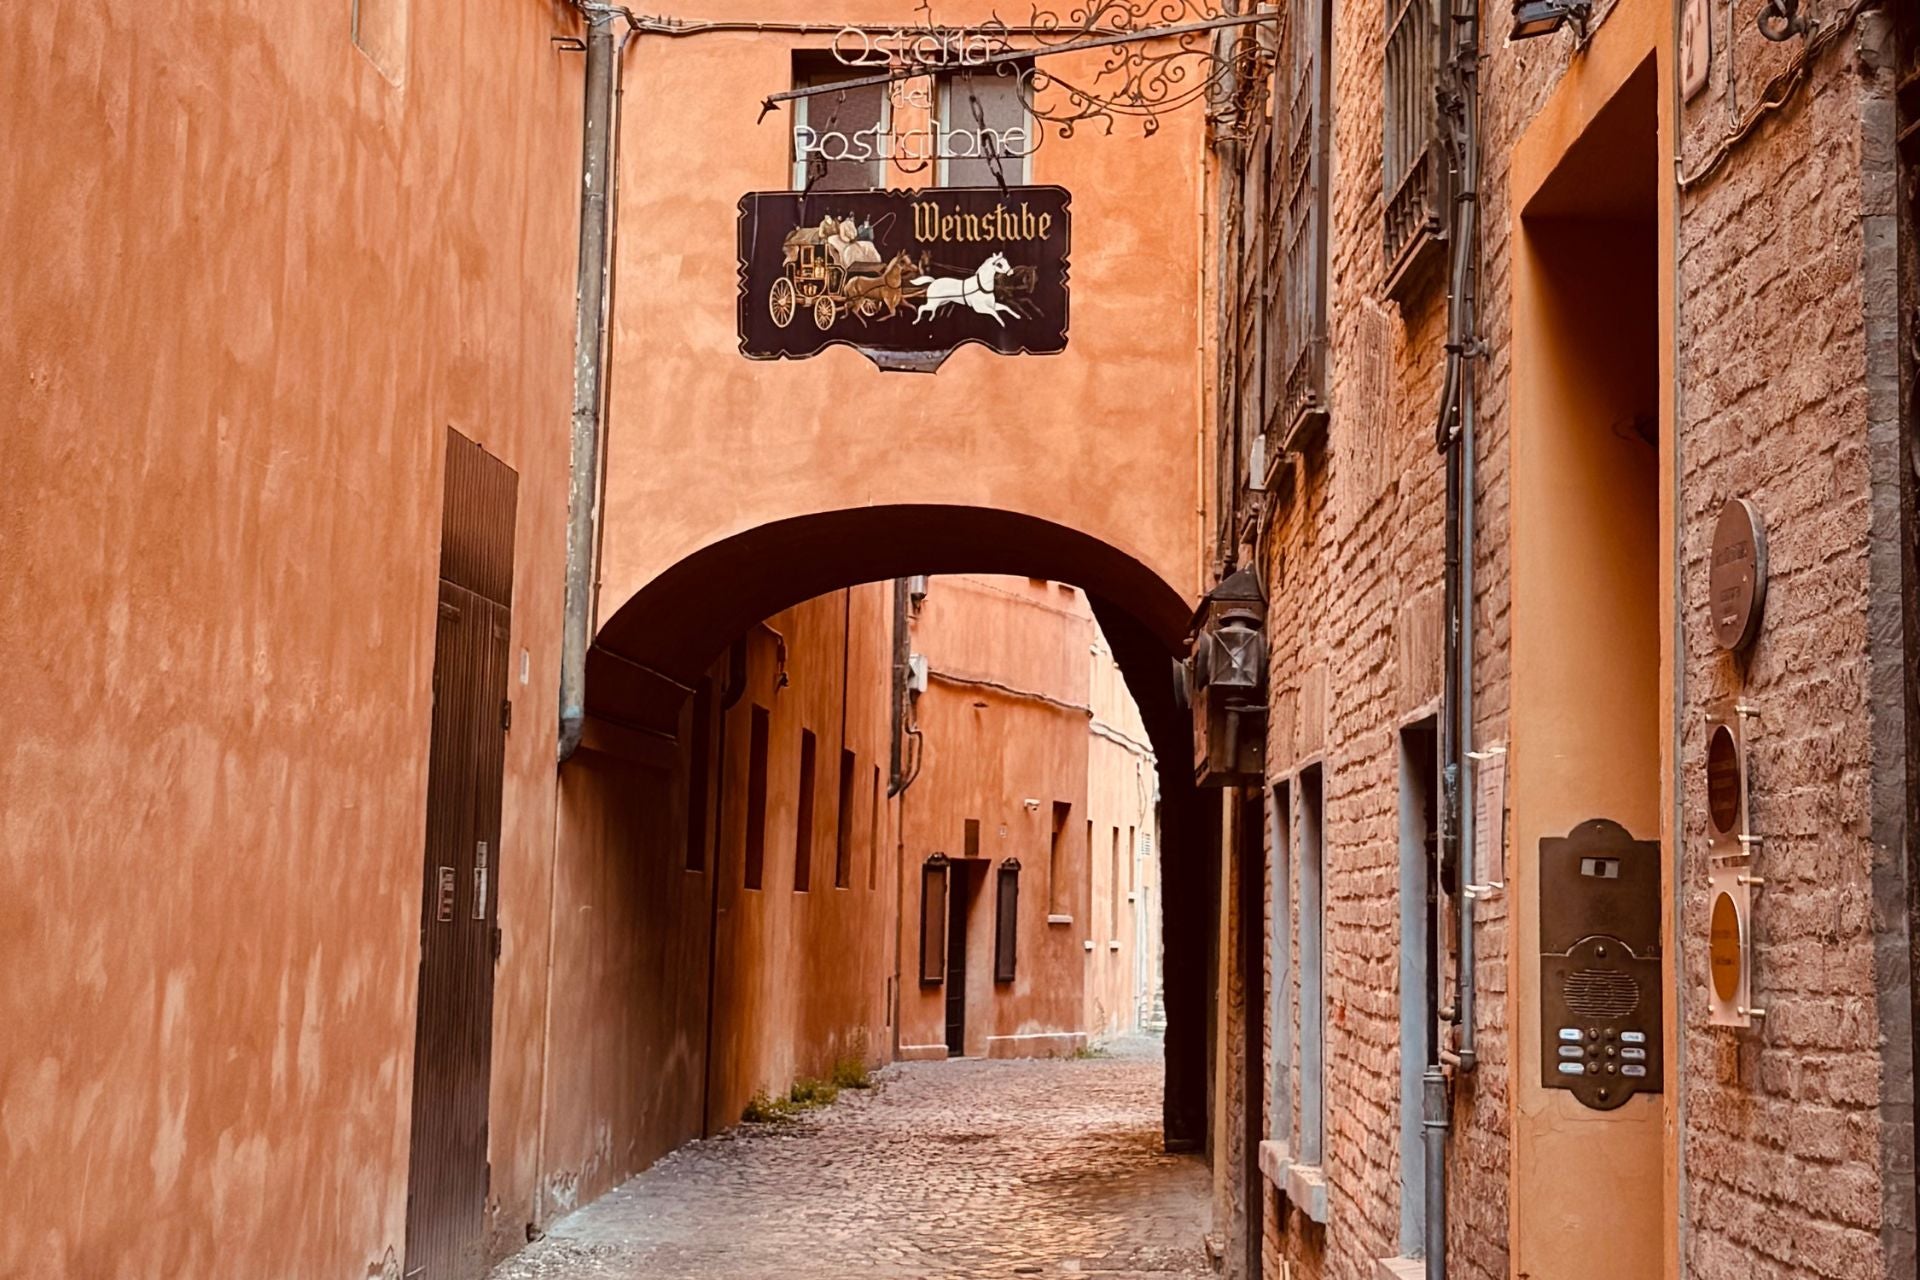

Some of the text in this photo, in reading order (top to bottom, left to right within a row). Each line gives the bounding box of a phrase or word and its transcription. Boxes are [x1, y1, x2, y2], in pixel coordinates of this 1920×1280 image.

[832, 27, 993, 66] Osteria
[890, 74, 932, 109] del
[794, 119, 1027, 172] Postiglione
[910, 201, 1053, 243] Weinstube
